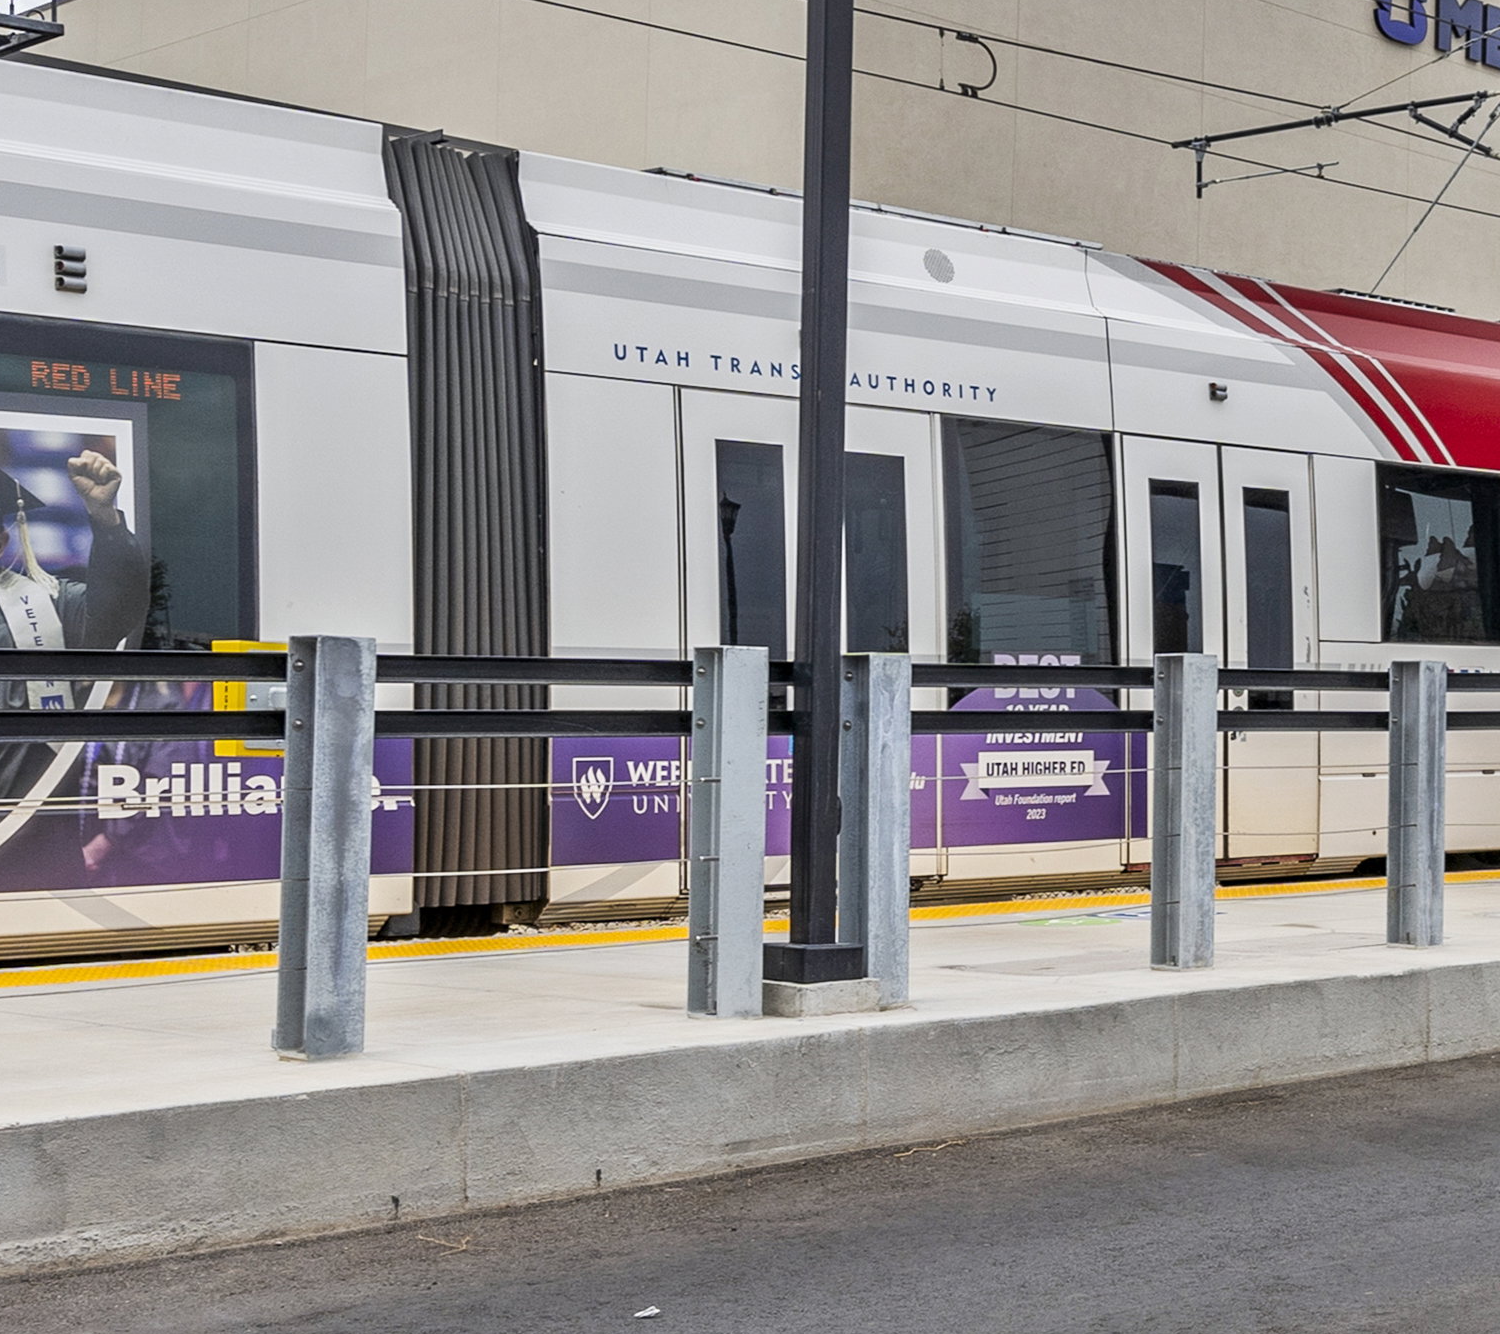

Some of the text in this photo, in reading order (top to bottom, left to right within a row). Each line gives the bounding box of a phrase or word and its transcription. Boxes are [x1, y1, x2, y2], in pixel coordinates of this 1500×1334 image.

[31, 360, 182, 400] RED LINE
[613, 343, 690, 368] UTAH
[849, 373, 998, 403] AUTHORITY
[986, 760, 1086, 777] UTAH HIGHER ED
[994, 792, 1077, 806] Utah Foundation report
[1026, 808, 1047, 820] 2023
